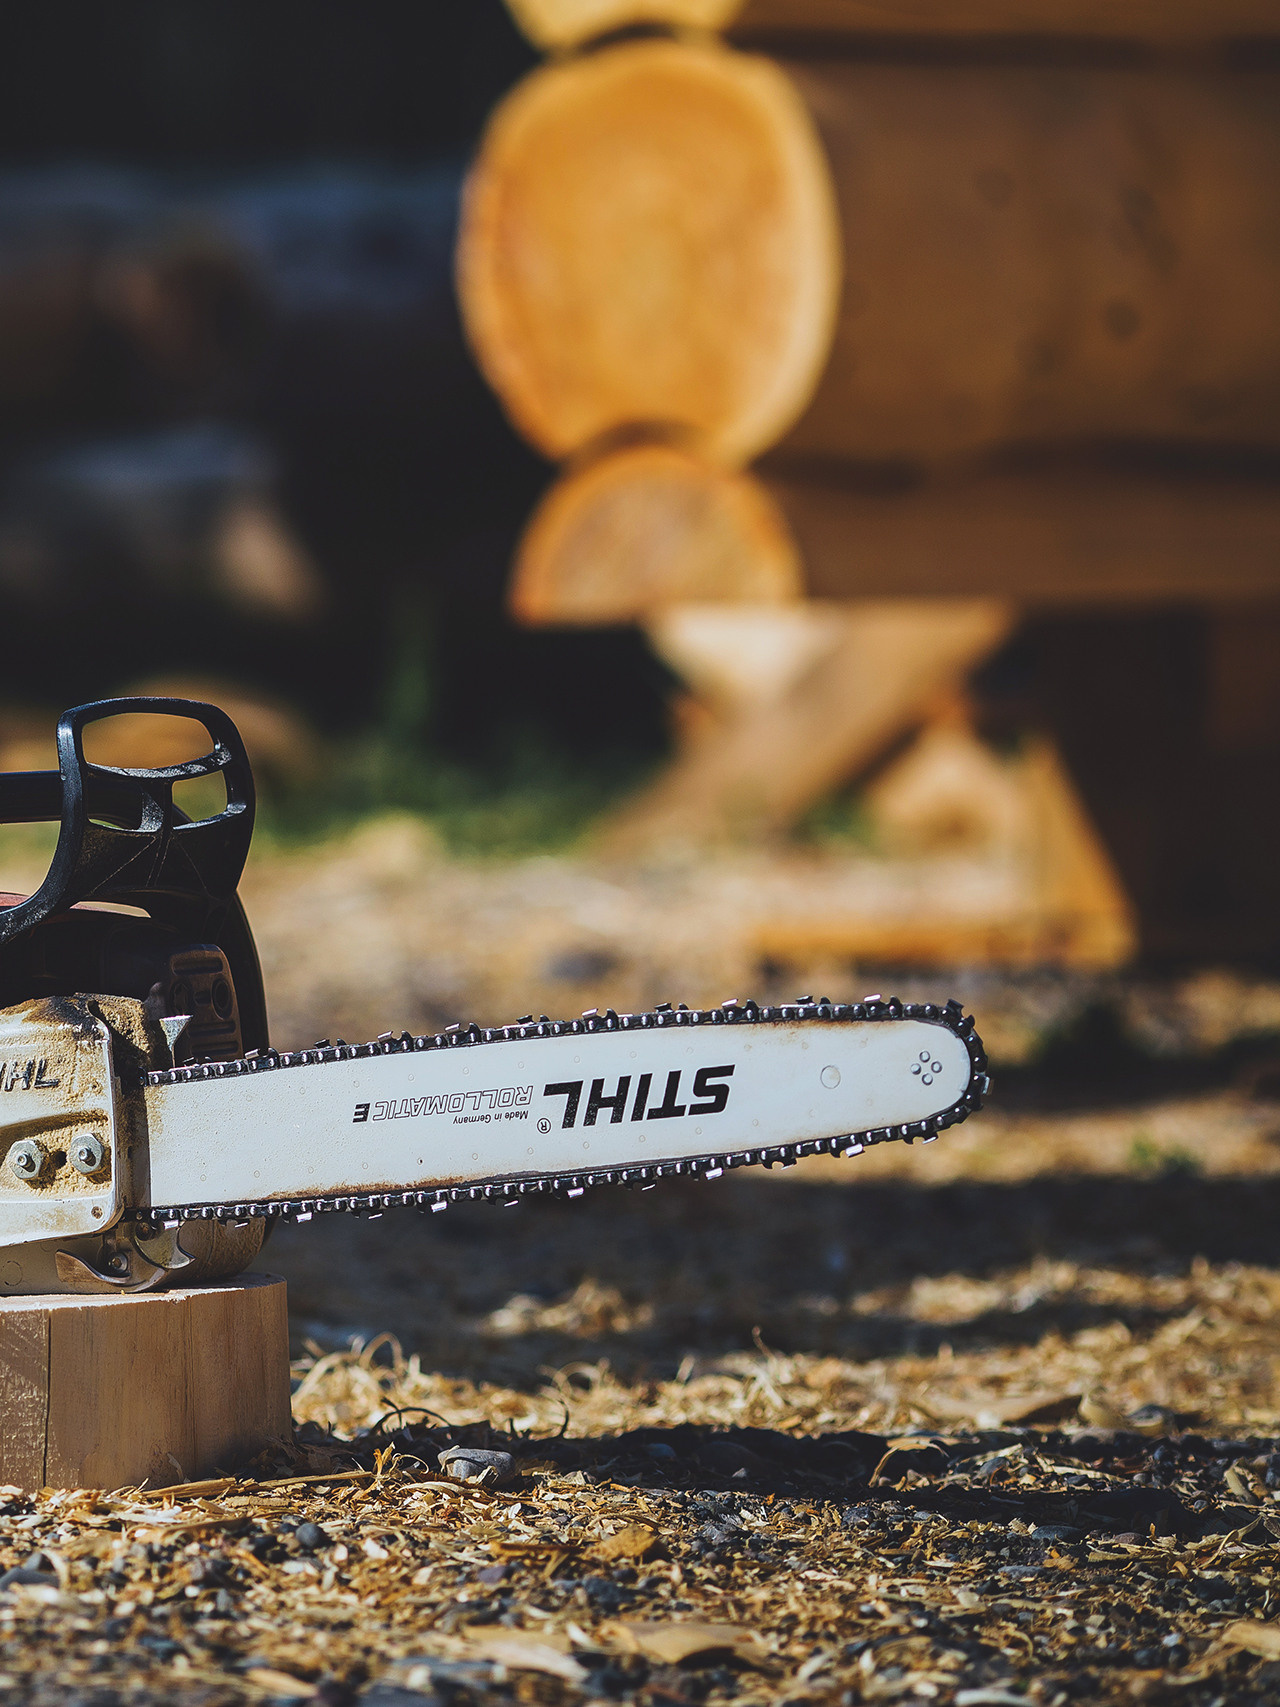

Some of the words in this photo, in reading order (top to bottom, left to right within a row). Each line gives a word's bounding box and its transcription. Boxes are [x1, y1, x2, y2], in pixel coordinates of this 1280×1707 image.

[543, 1064, 736, 1129] STIHL
[373, 1085, 534, 1121] ROLLOMATIC
[452, 1114, 492, 1125] Germany
[494, 1112, 502, 1122] in
[504, 1110, 529, 1120] Made
